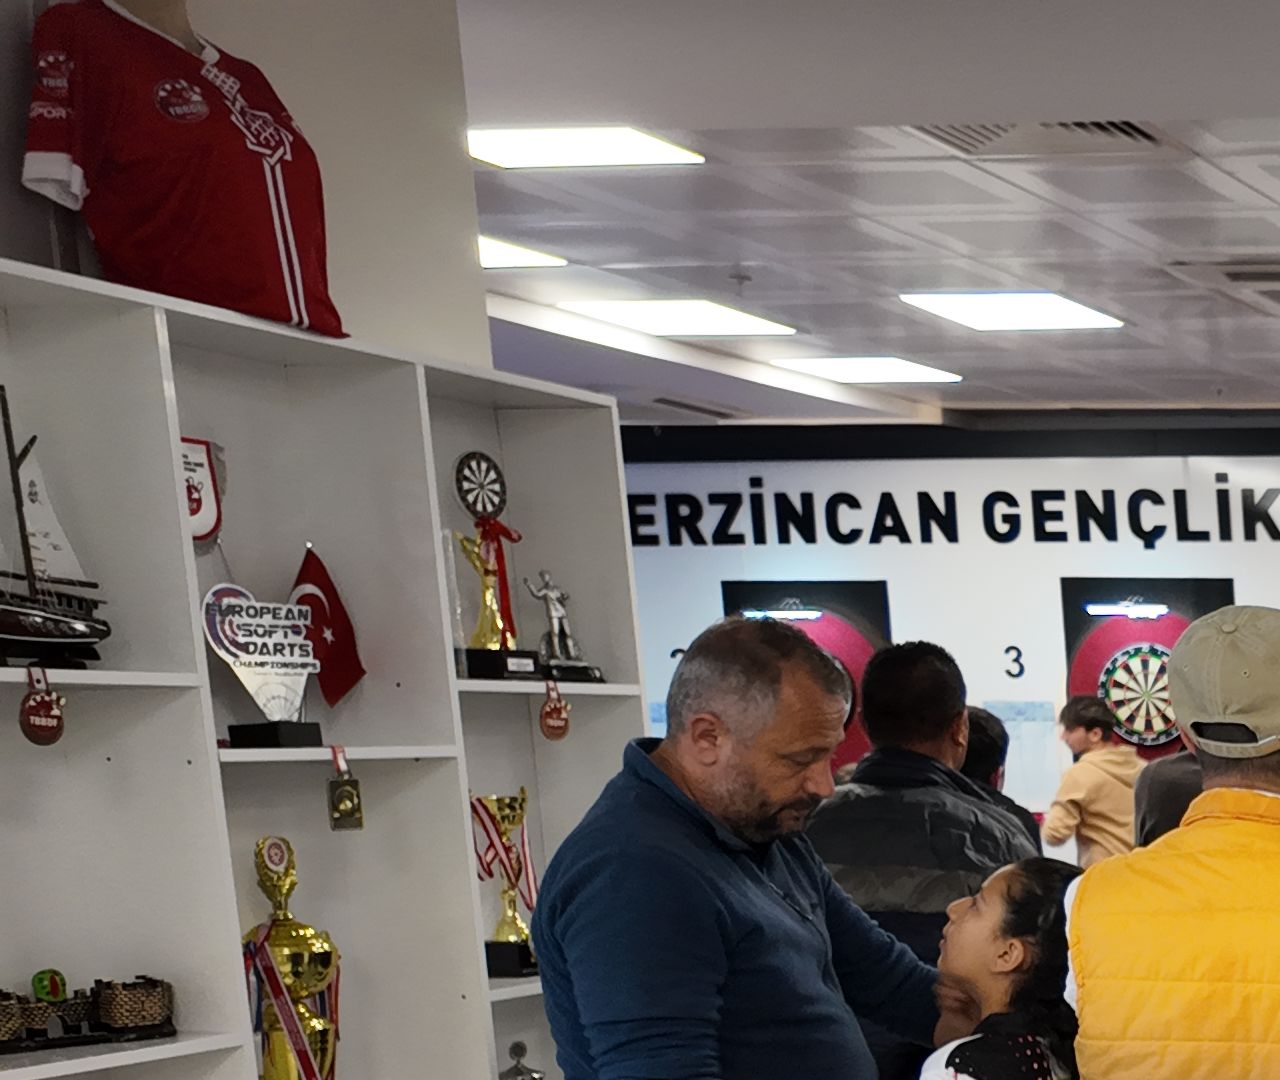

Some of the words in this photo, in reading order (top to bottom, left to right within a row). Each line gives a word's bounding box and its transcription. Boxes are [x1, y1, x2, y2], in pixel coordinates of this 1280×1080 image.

[627, 476, 960, 547] ERZİNCAN
[205, 602, 309, 621] EUROPEAN
[246, 641, 311, 658] DARTS
[1004, 645, 1026, 679] 3
